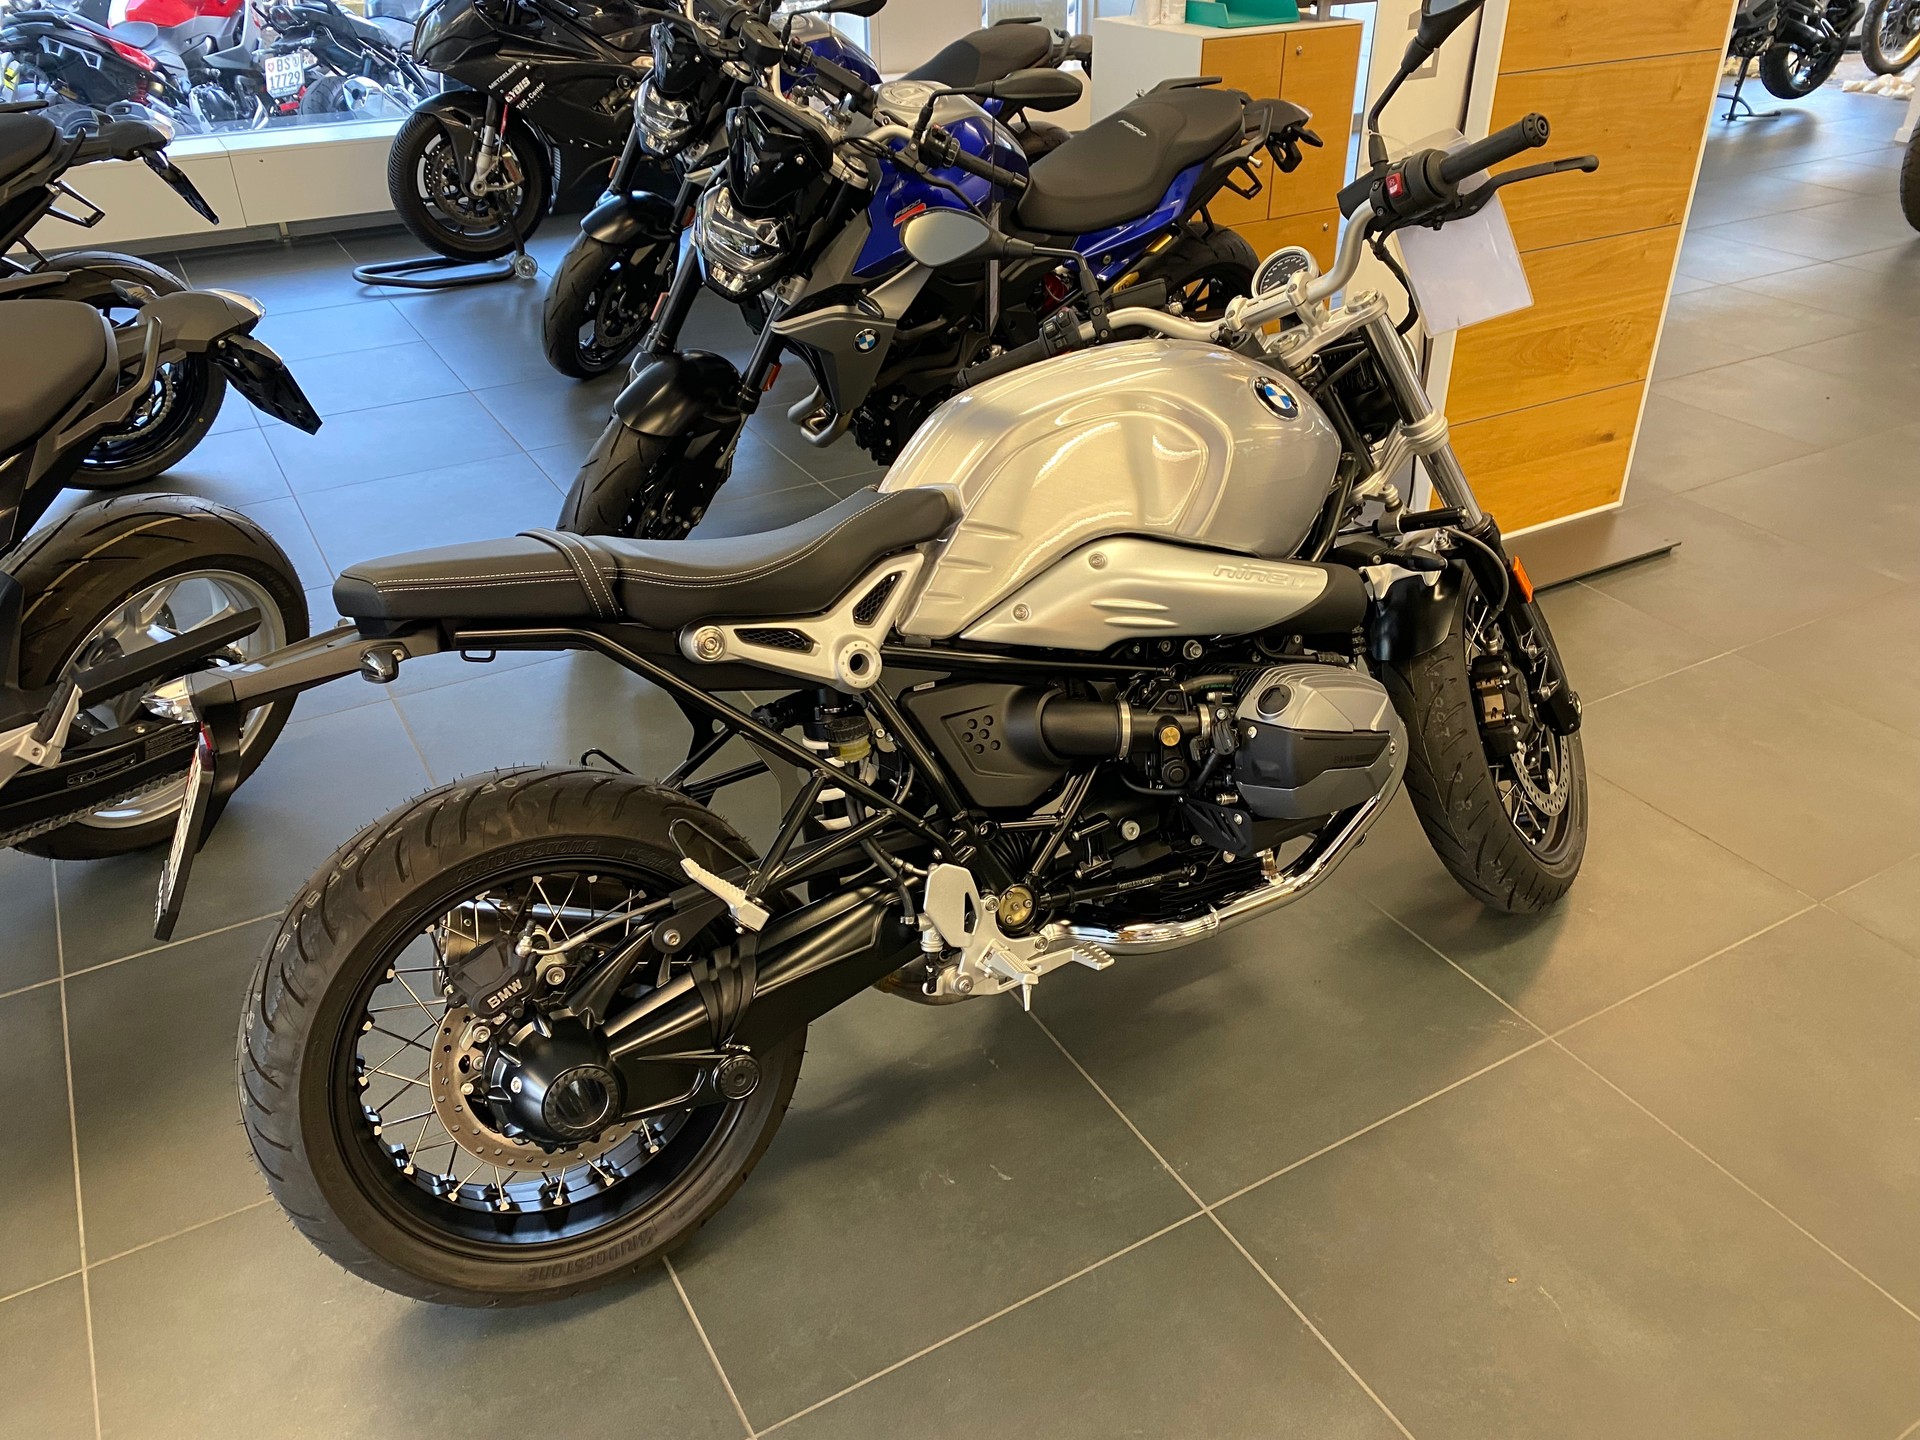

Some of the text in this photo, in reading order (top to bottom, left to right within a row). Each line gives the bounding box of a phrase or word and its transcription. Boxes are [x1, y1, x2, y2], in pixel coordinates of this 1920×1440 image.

[276, 57, 290, 71] BS
[488, 64, 517, 90] METZELER
[269, 71, 300, 89] 17729
[456, 840, 599, 882] BRIDGESTONE
[487, 978, 522, 1009] BMW
[527, 1227, 656, 1282] BRIDGESTONE
